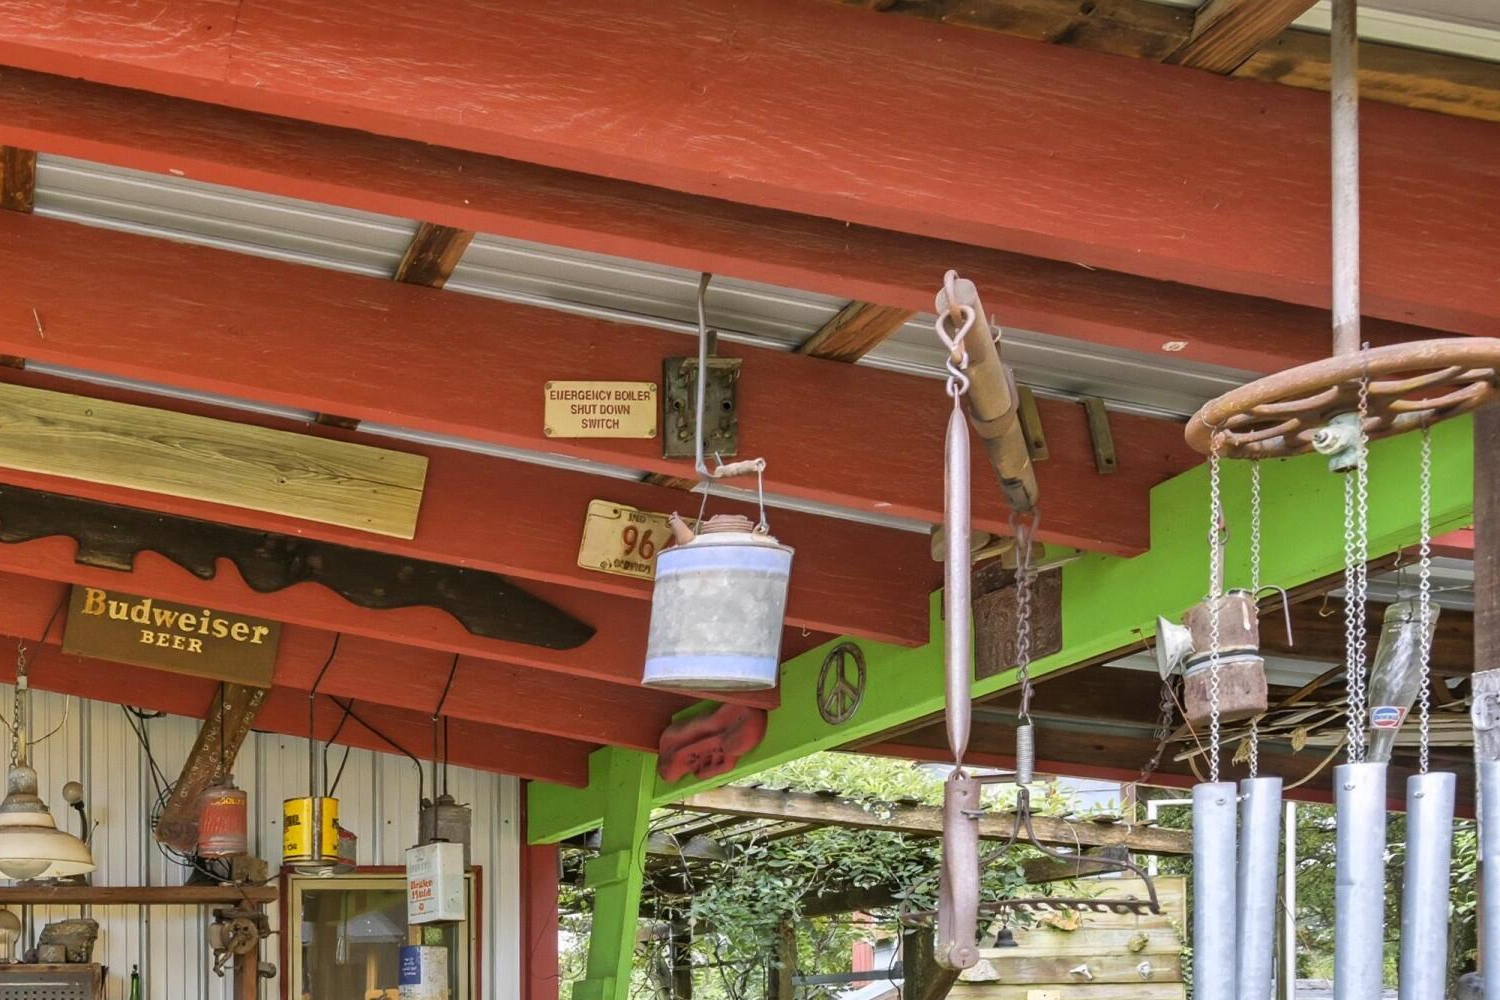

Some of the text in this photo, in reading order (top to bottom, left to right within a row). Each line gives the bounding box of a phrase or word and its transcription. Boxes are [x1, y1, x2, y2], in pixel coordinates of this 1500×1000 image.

[550, 390, 651, 401] EMERGENCY BOILER
[570, 404, 631, 415] SHUT DOWN
[581, 418, 620, 430] SWITCH
[81, 587, 270, 645] Budweiser
[140, 629, 204, 654] BEER
